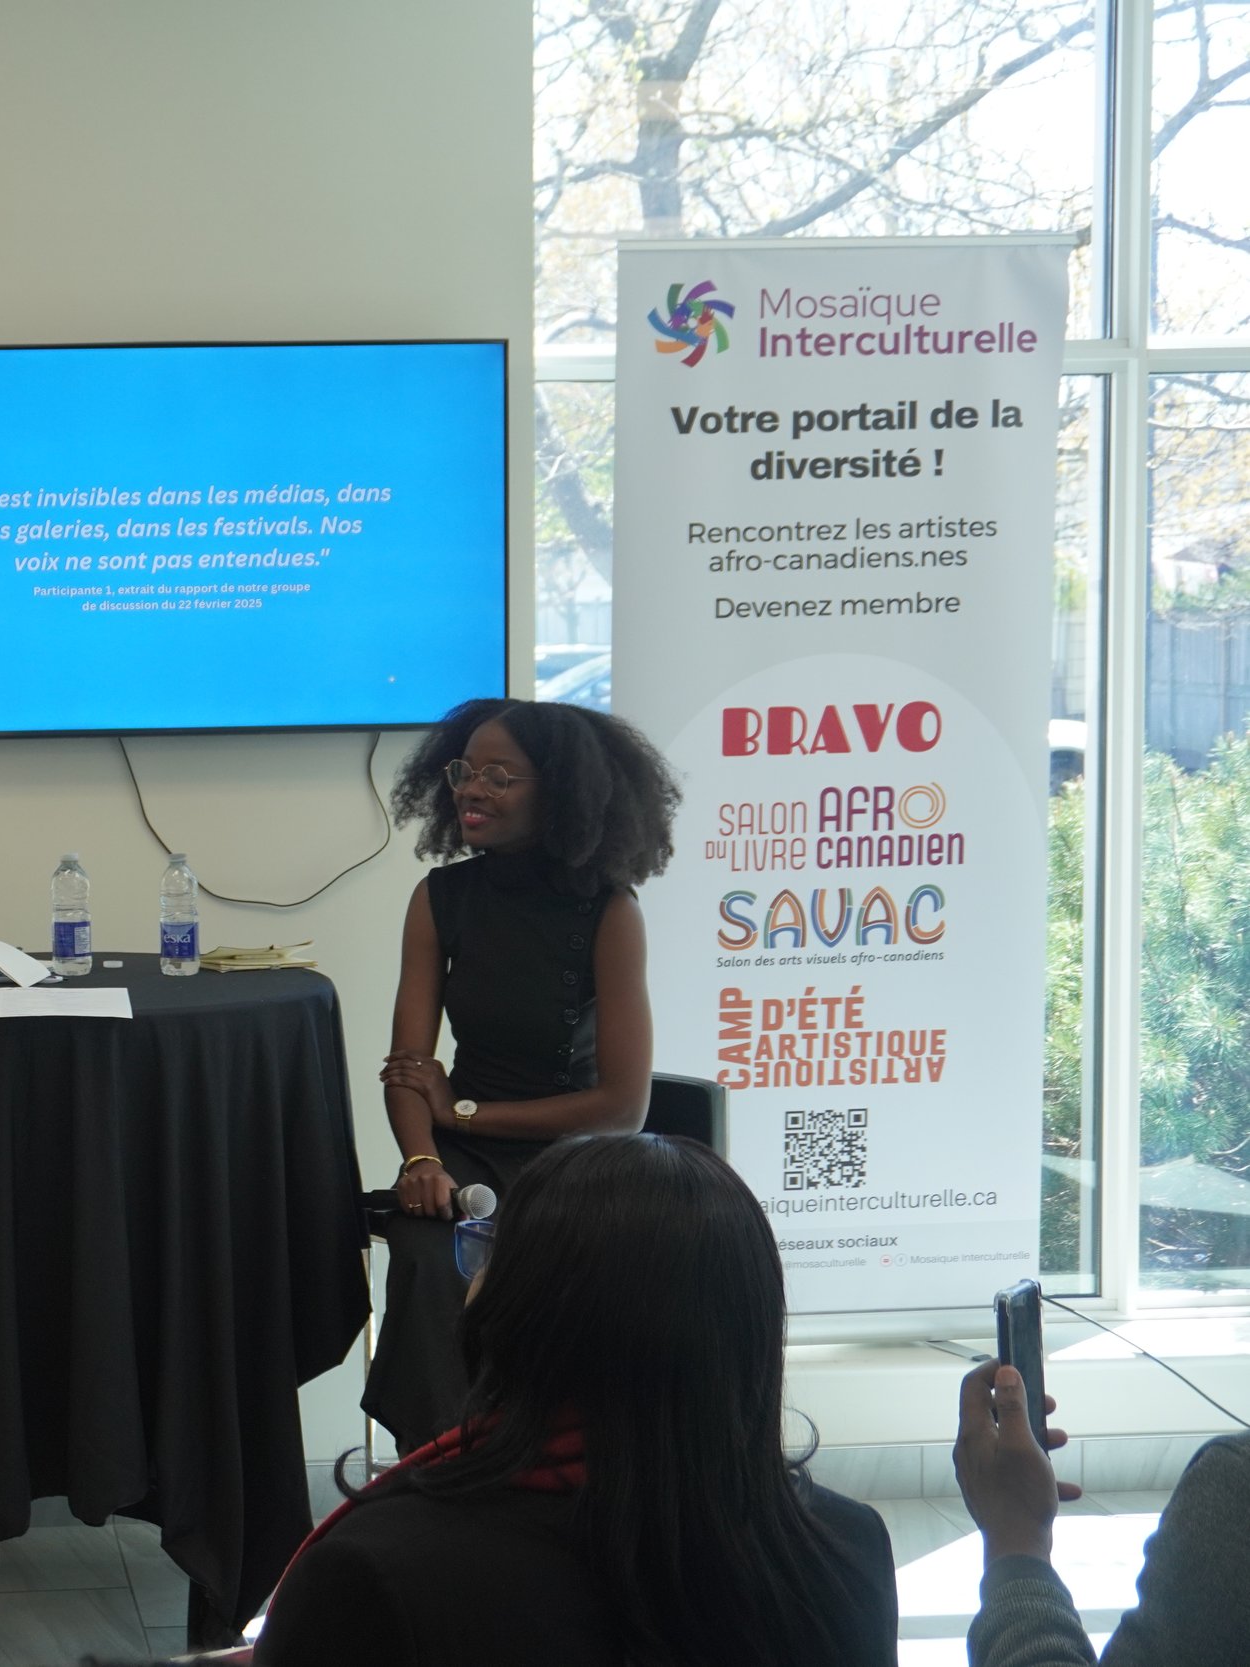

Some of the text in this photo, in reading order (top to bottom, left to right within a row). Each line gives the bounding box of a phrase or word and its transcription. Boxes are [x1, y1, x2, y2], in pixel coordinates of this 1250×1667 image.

[761, 286, 940, 325] Mosaïque
[760, 323, 1037, 357] Interculturelle
[671, 399, 1023, 440] Votre portail de la
[751, 448, 943, 480] diversité !
[37, 487, 141, 507] invisibles
[147, 486, 202, 506] dans
[207, 485, 238, 505] les
[244, 484, 330, 506] médias,
[337, 483, 391, 503] dans
[14, 519, 109, 544] galeries,
[117, 518, 171, 538] dans
[176, 517, 208, 537] les
[214, 516, 312, 536] festivals.
[320, 516, 362, 535] Nos
[689, 516, 997, 543] Rencontrez les artistes
[15, 548, 330, 574] voix ne sont pas entendues."
[709, 546, 967, 572] afro-canadiens.nes
[34, 581, 310, 597] Participante 1, extrait du rapport de notre groupe
[82, 599, 262, 611] de discussion du 22 février 2025
[715, 592, 960, 619] Devenez membre
[722, 701, 941, 756] BRAVO
[819, 783, 945, 832] AFRO
[706, 841, 726, 859] DU
[718, 884, 945, 951] SAVAC
[165, 933, 191, 945] eska
[717, 950, 944, 967] Salon des arts visuels afro-canadiens
[762, 985, 864, 1031] D’ÉTÉ
[717, 987, 752, 1090] CAMP
[754, 1029, 947, 1060] ARTISTIQUE
[759, 1190, 997, 1216] aiqueinterculturelle.ca
[838, 1235, 897, 1248] sociaux
